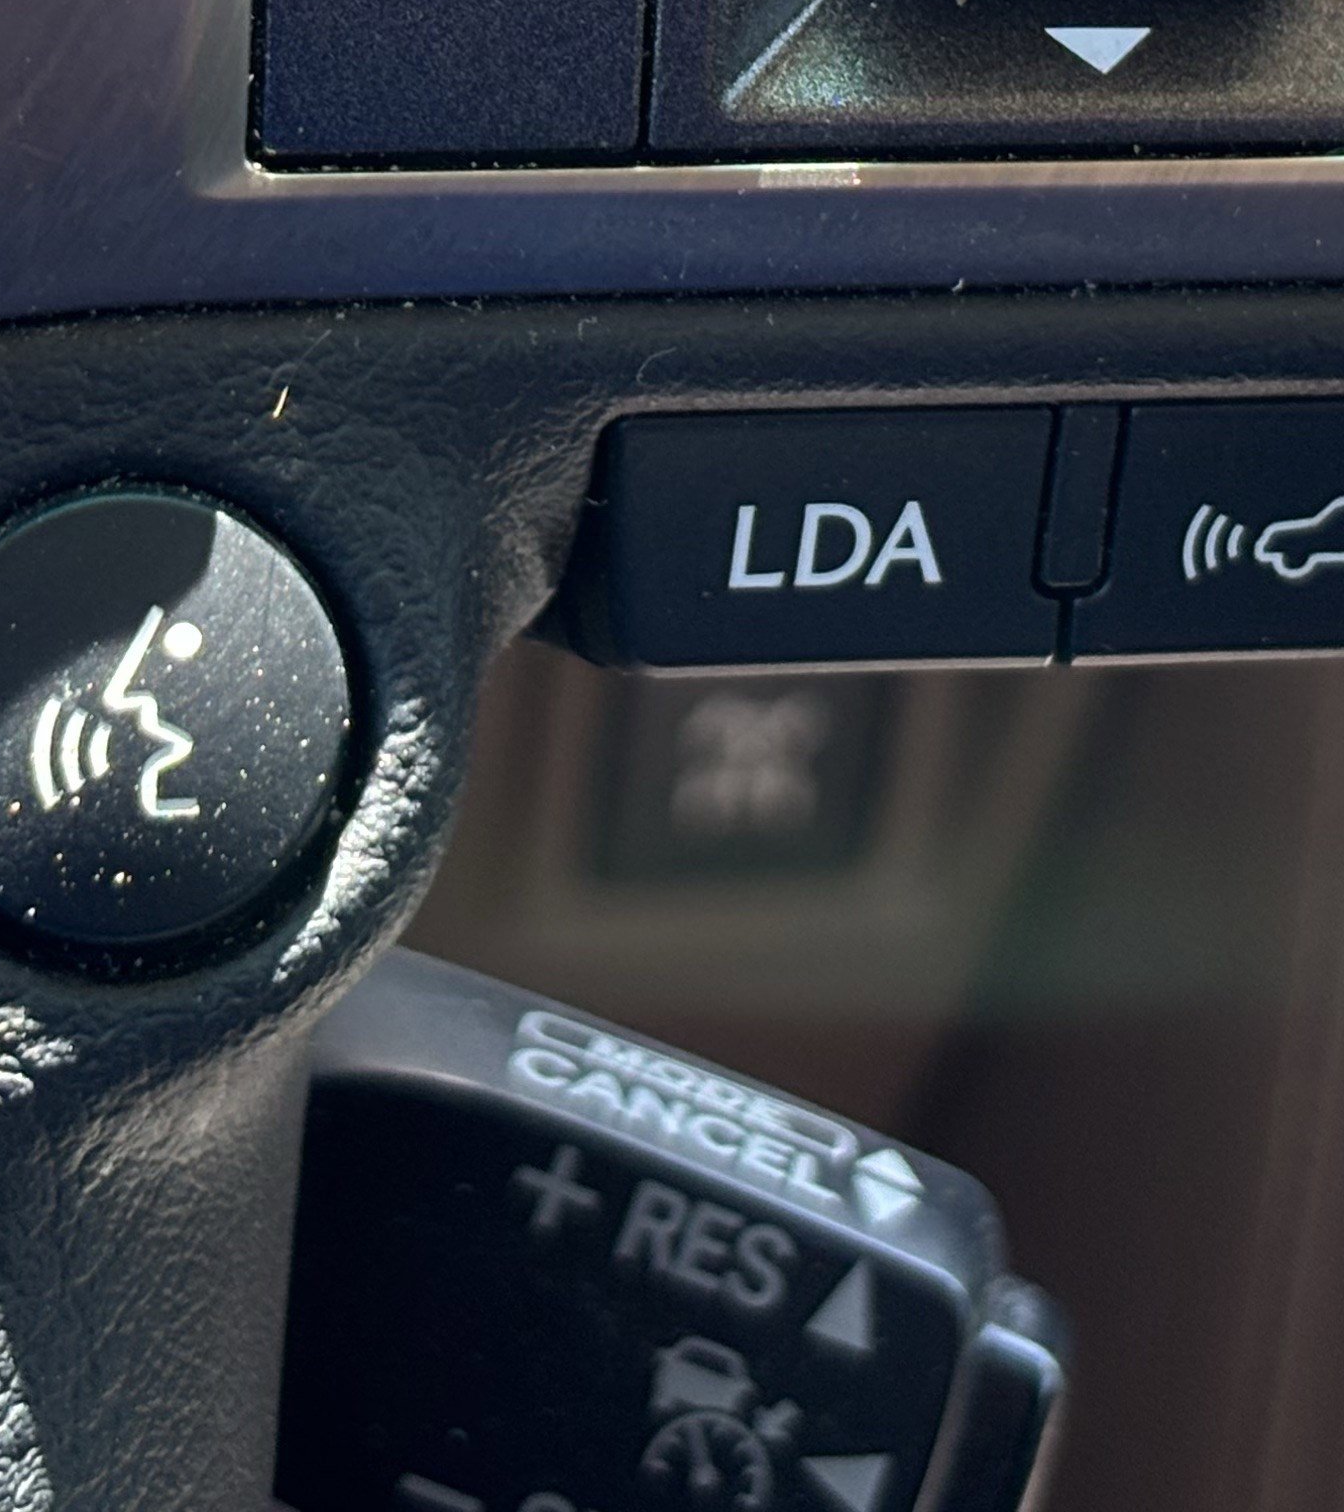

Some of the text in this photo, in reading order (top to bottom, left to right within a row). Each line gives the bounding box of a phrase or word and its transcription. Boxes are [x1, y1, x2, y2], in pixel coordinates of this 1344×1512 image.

[728, 500, 943, 589] LDA
[508, 1048, 846, 1205] CANCEL
[615, 1180, 799, 1309] RES
